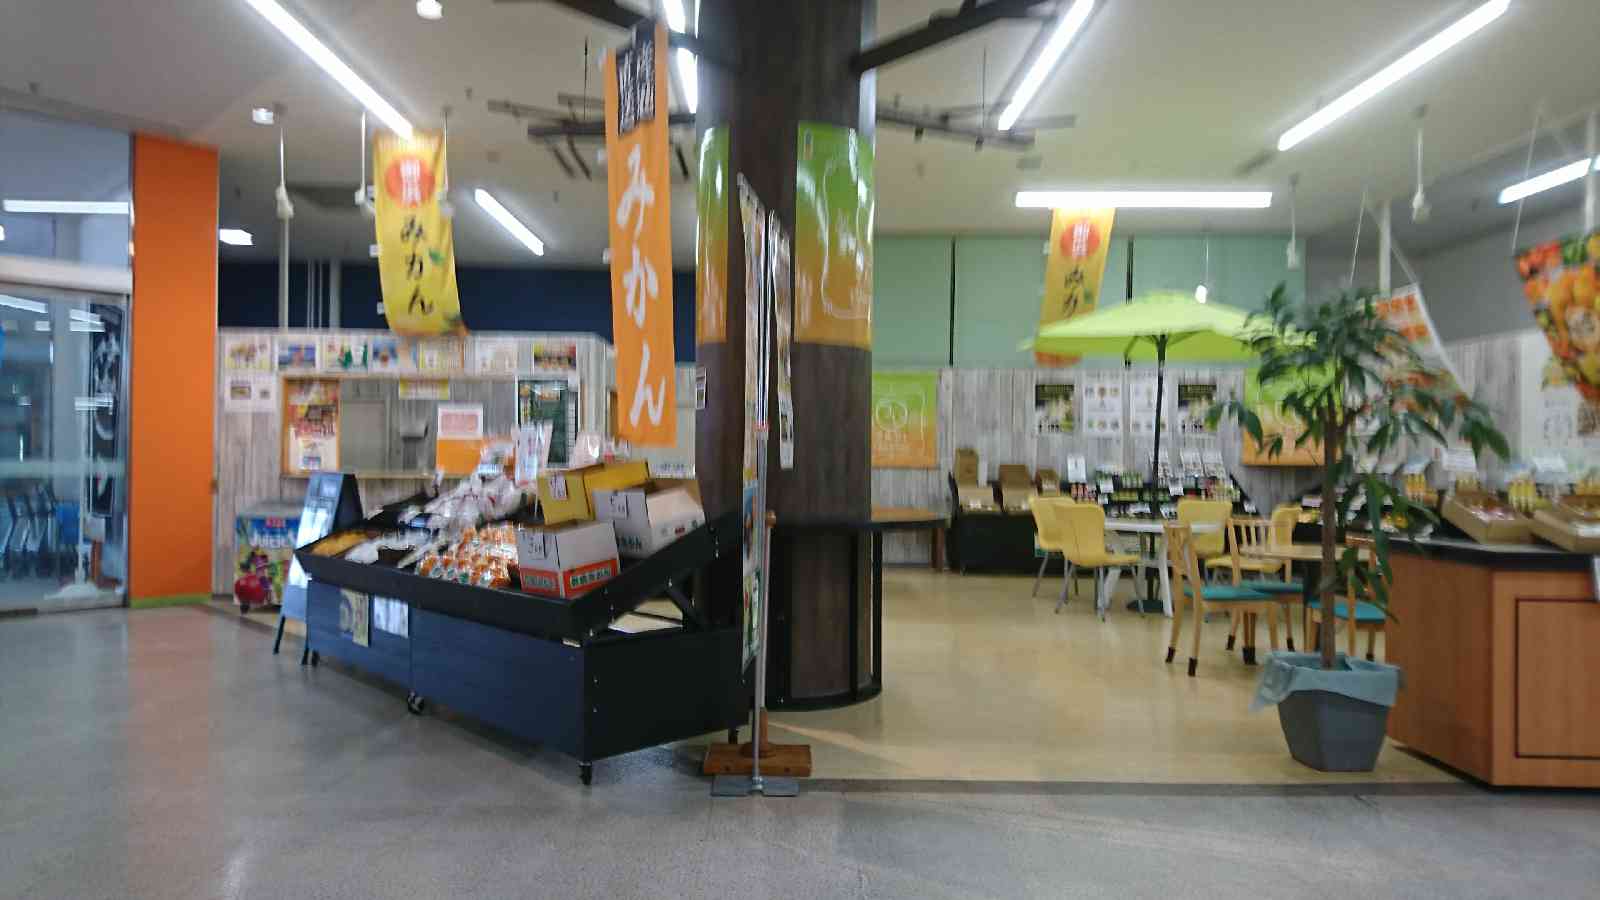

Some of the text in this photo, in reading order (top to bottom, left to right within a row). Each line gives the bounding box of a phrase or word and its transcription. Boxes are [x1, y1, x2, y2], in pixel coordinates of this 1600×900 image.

[401, 215, 434, 316] みかん
[616, 143, 666, 427] みかん
[1063, 266, 1085, 319] みか
